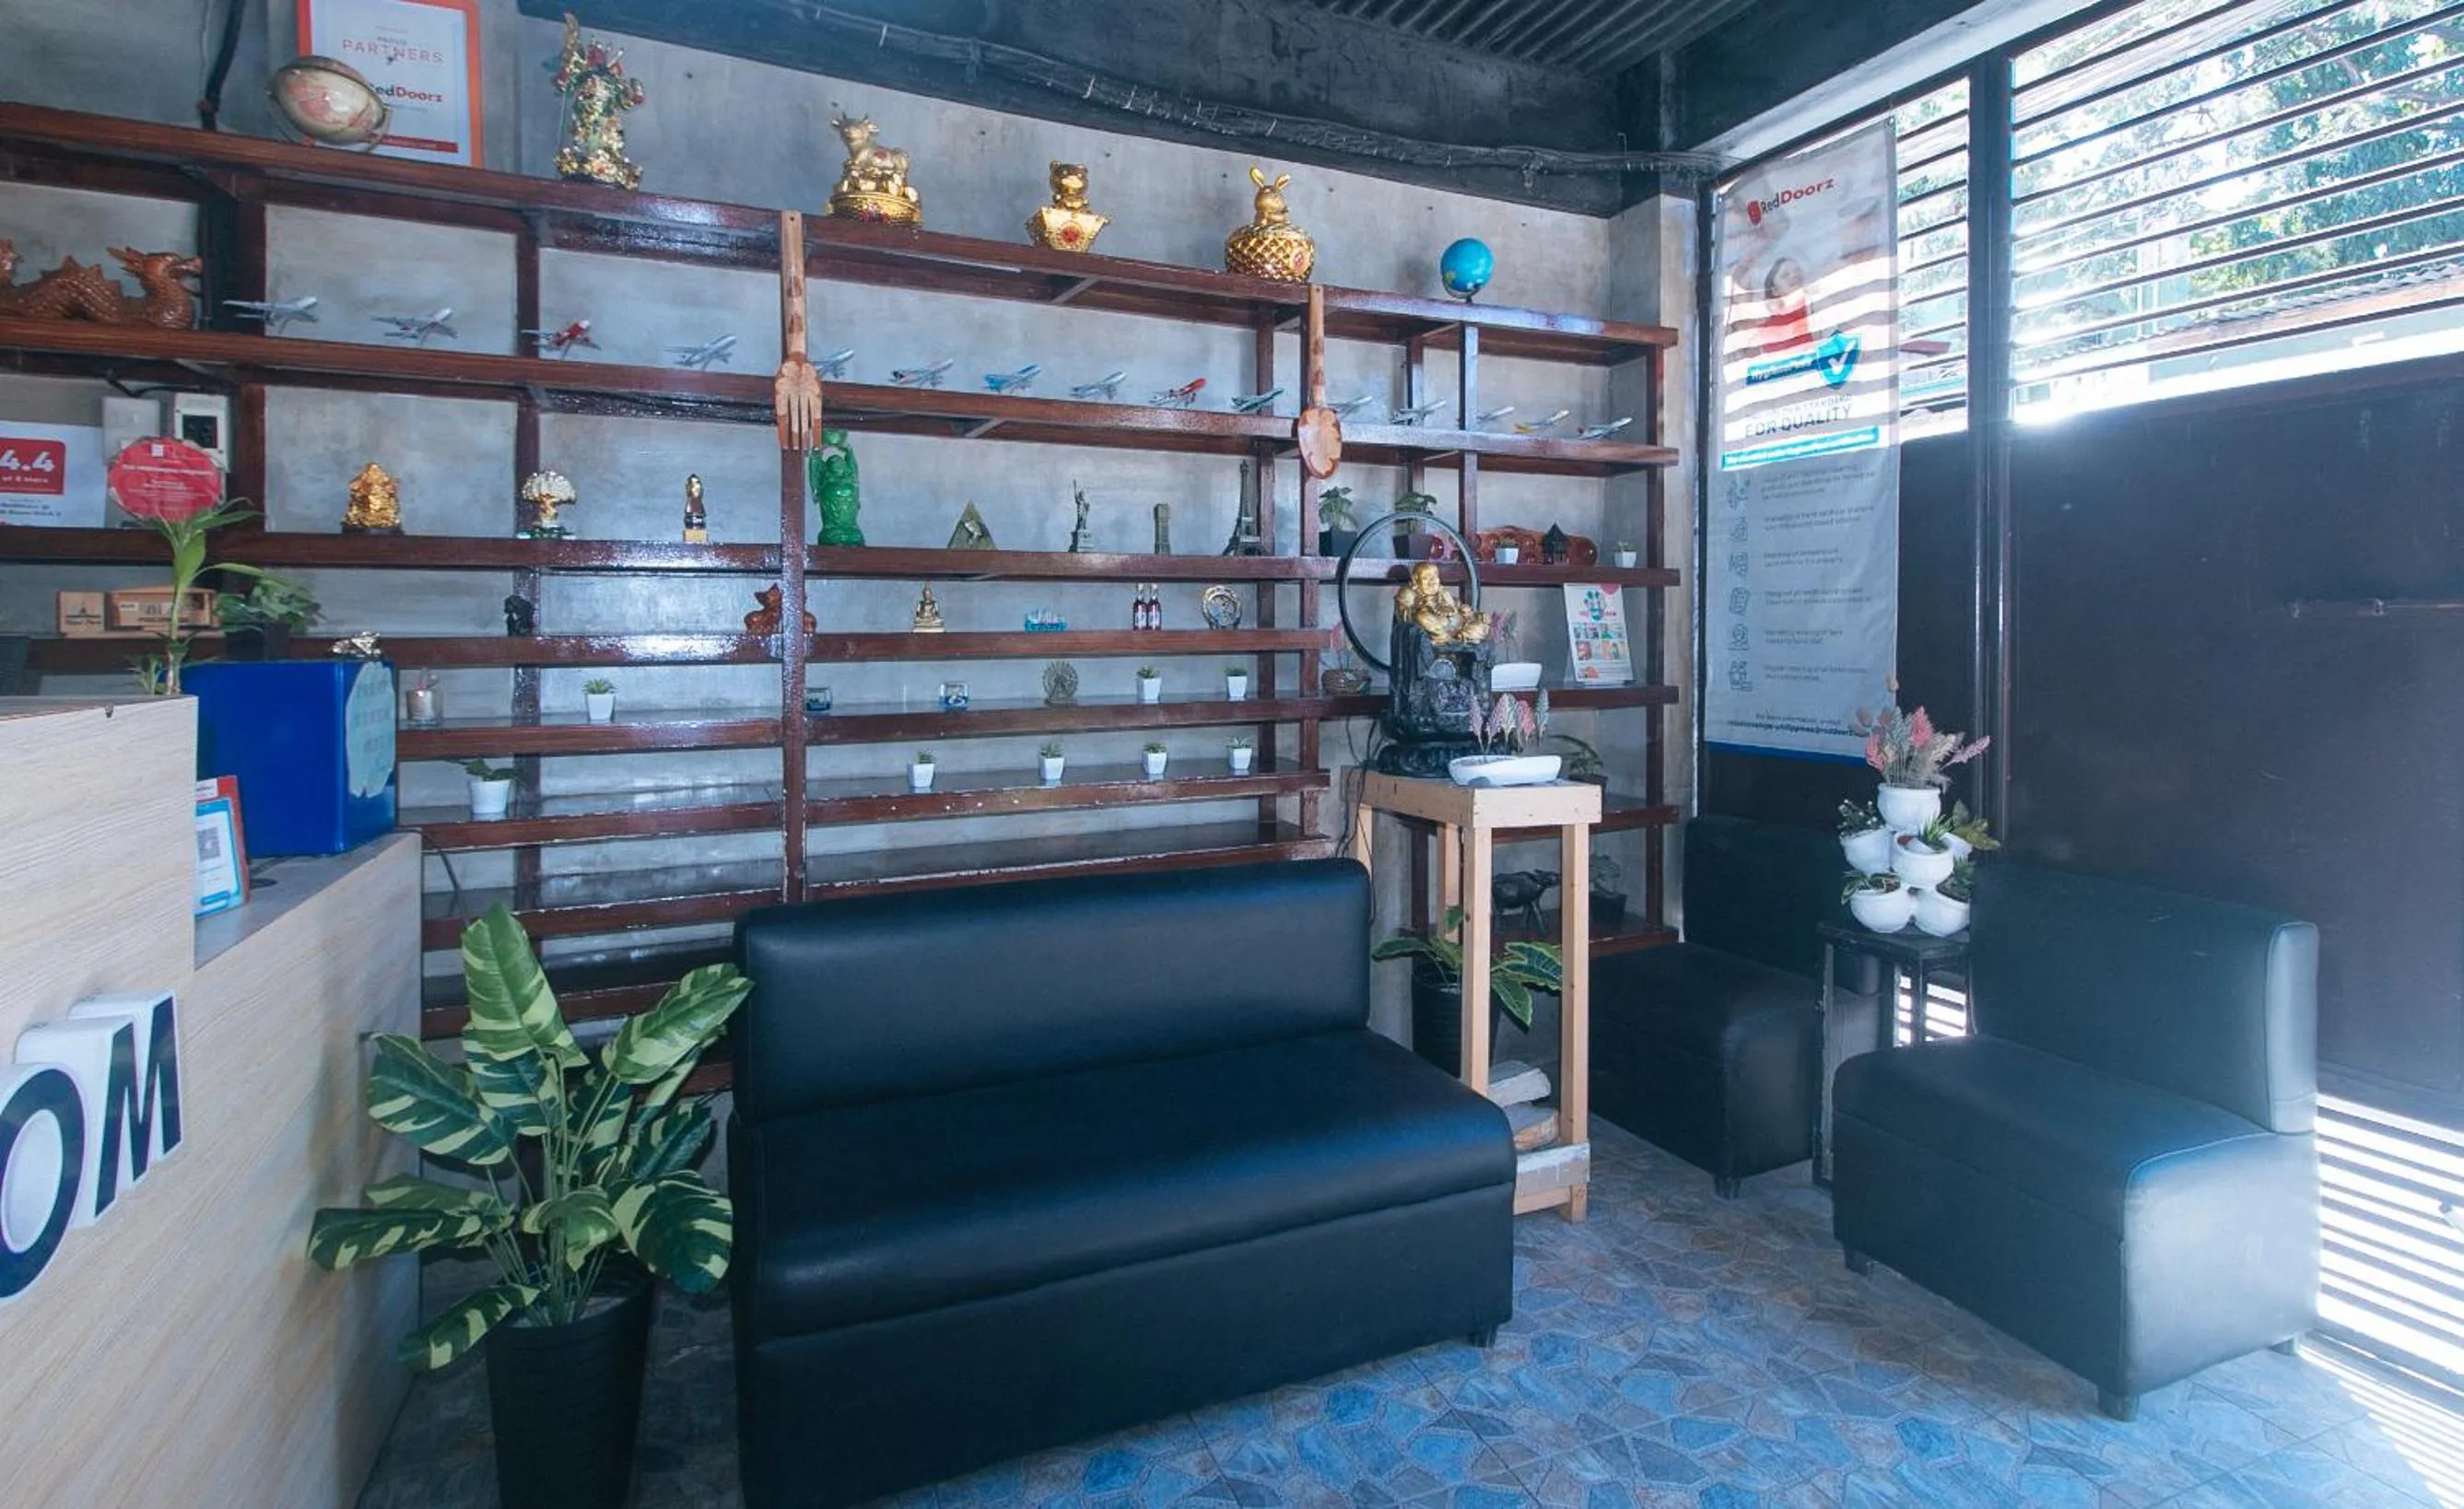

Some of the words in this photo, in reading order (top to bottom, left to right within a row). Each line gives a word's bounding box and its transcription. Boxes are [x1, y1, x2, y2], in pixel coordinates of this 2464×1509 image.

[341, 38, 444, 65] PARTNERS
[370, 82, 443, 103] edDoorz
[1760, 178, 1835, 214] RedDoorz
[1780, 404, 1853, 433] QUALITY
[0, 449, 55, 473] 4.4
